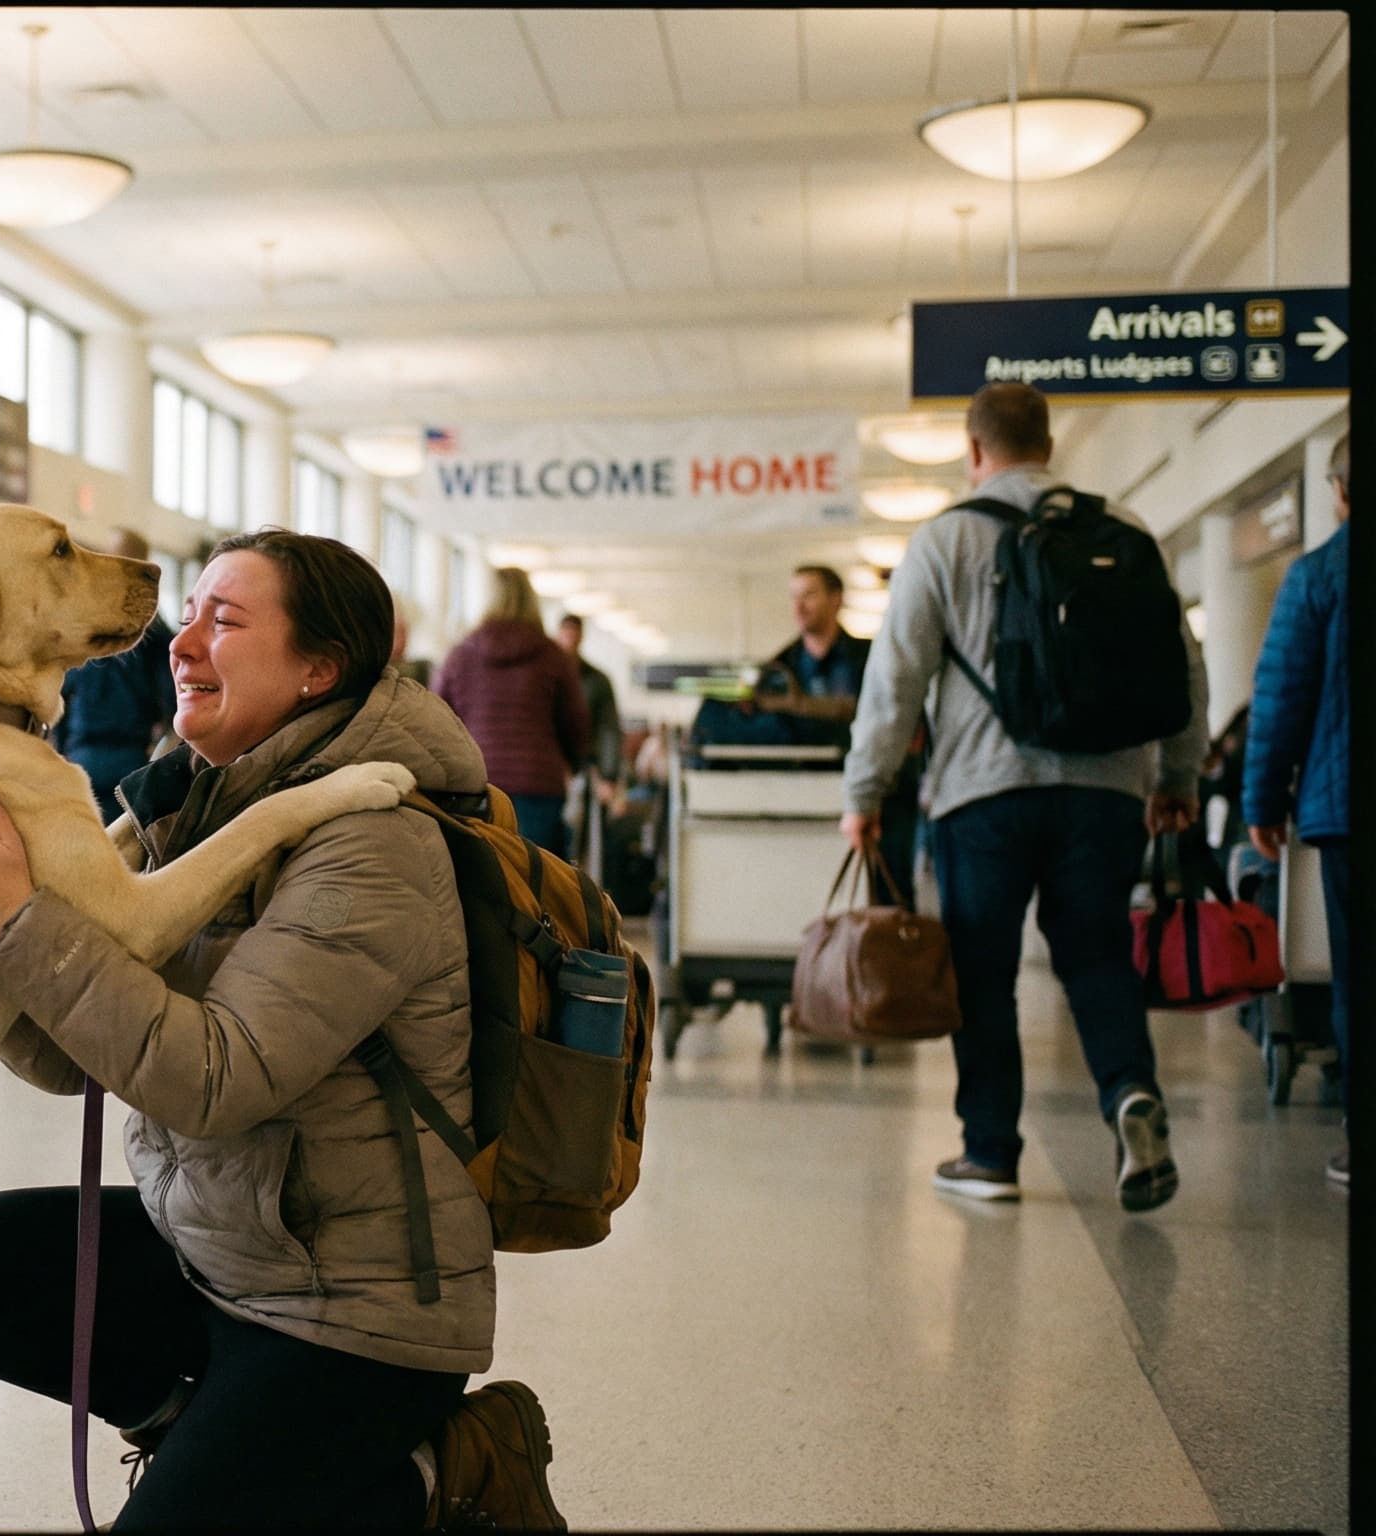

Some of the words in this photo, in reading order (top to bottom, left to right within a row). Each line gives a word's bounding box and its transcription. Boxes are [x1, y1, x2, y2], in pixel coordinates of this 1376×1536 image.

[1088, 302, 1236, 341] Arrivals
[438, 458, 674, 497] WELCOME
[690, 453, 838, 494] HOME
